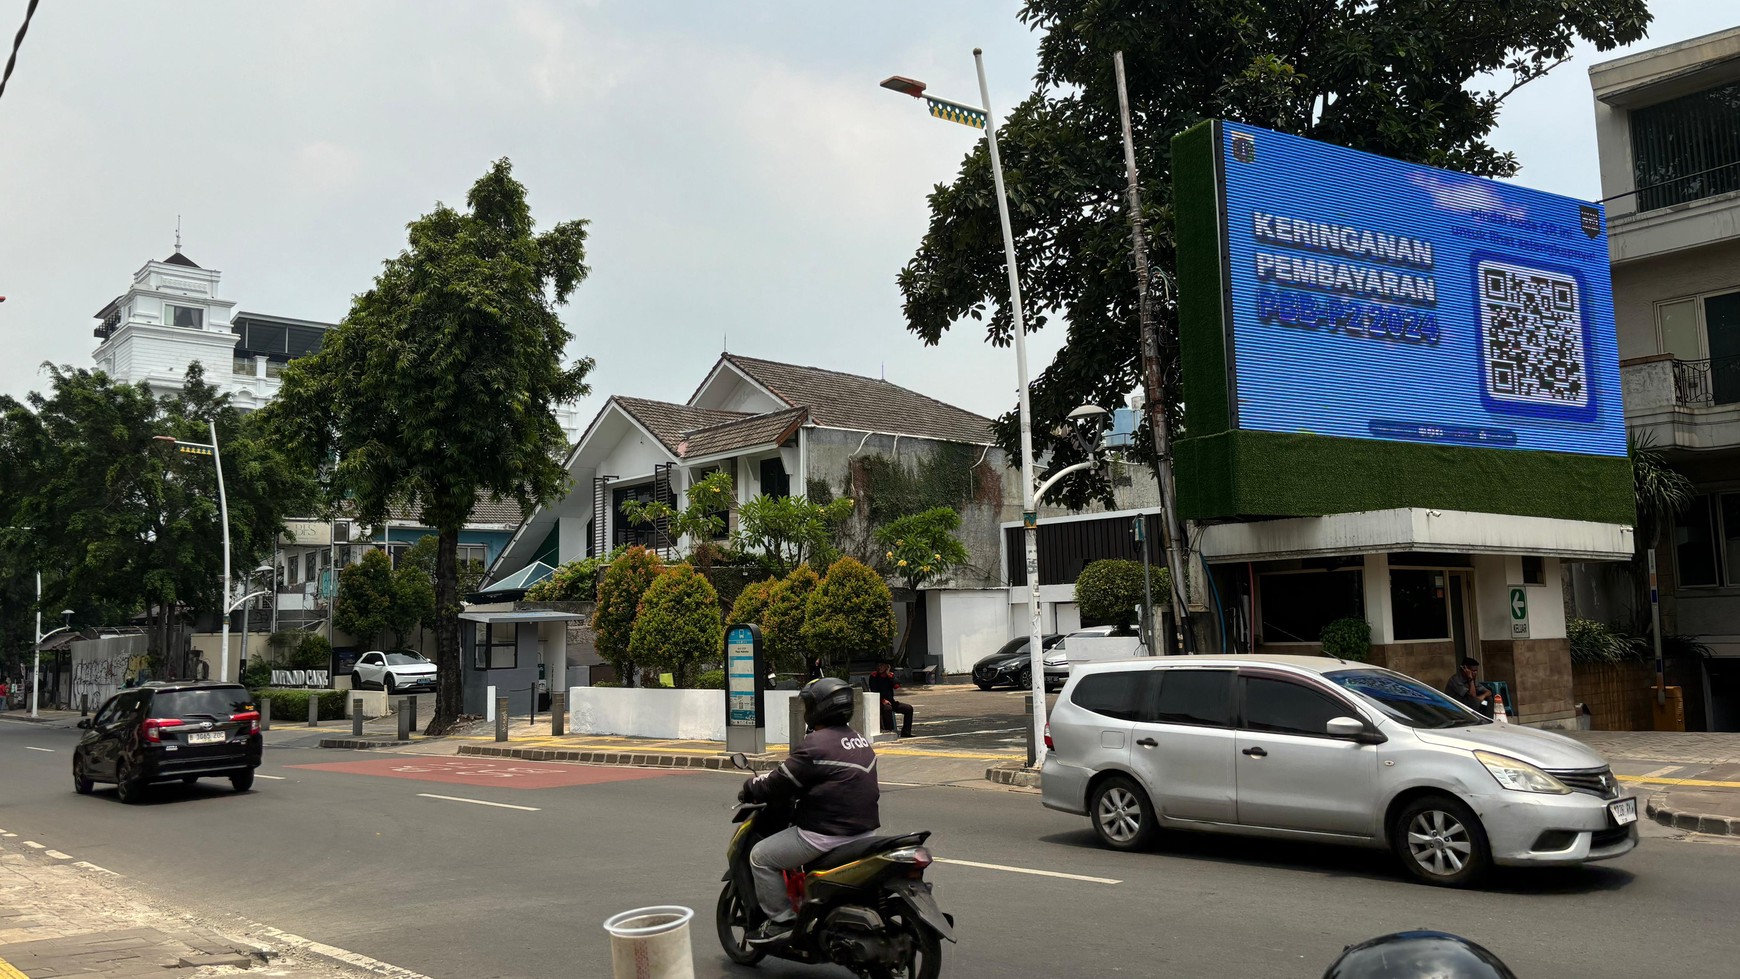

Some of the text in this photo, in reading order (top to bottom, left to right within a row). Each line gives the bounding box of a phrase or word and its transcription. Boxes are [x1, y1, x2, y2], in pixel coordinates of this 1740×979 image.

[1254, 211, 1432, 264] KERINGANAN
[1452, 226, 1488, 241] untuk
[1540, 222, 1560, 236] QR
[1257, 252, 1435, 301] PEMBAYARAN
[1257, 288, 1439, 343] PBB-P2 2024
[1513, 623, 1527, 633] KELUAR
[306, 669, 329, 686] CAKE
[840, 733, 869, 750] Grab
